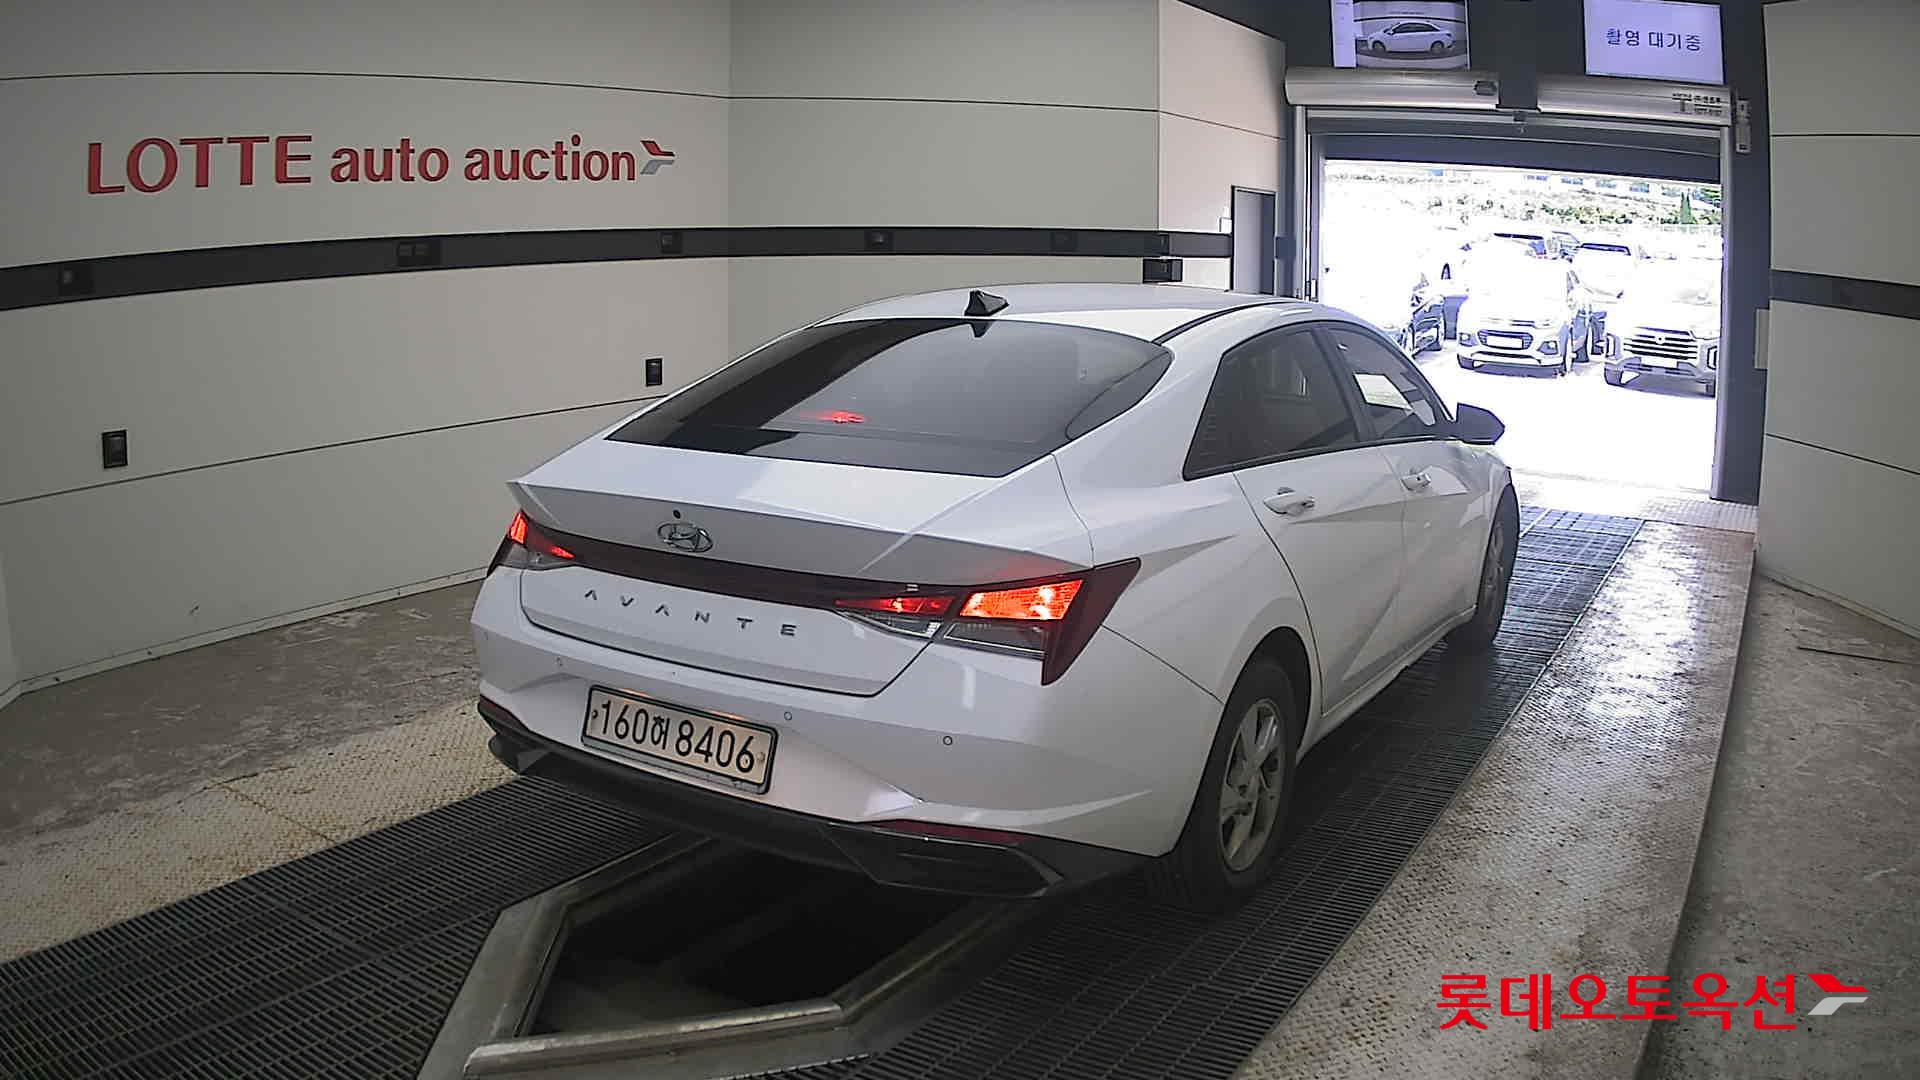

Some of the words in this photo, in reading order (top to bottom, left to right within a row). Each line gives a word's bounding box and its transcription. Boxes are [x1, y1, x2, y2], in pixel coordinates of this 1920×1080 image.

[1648, 31, 1701, 52] 대기중
[87, 134, 313, 194] LOTTE
[330, 138, 449, 183] auto
[463, 134, 635, 182] auction
[584, 589, 797, 637] AVANTE
